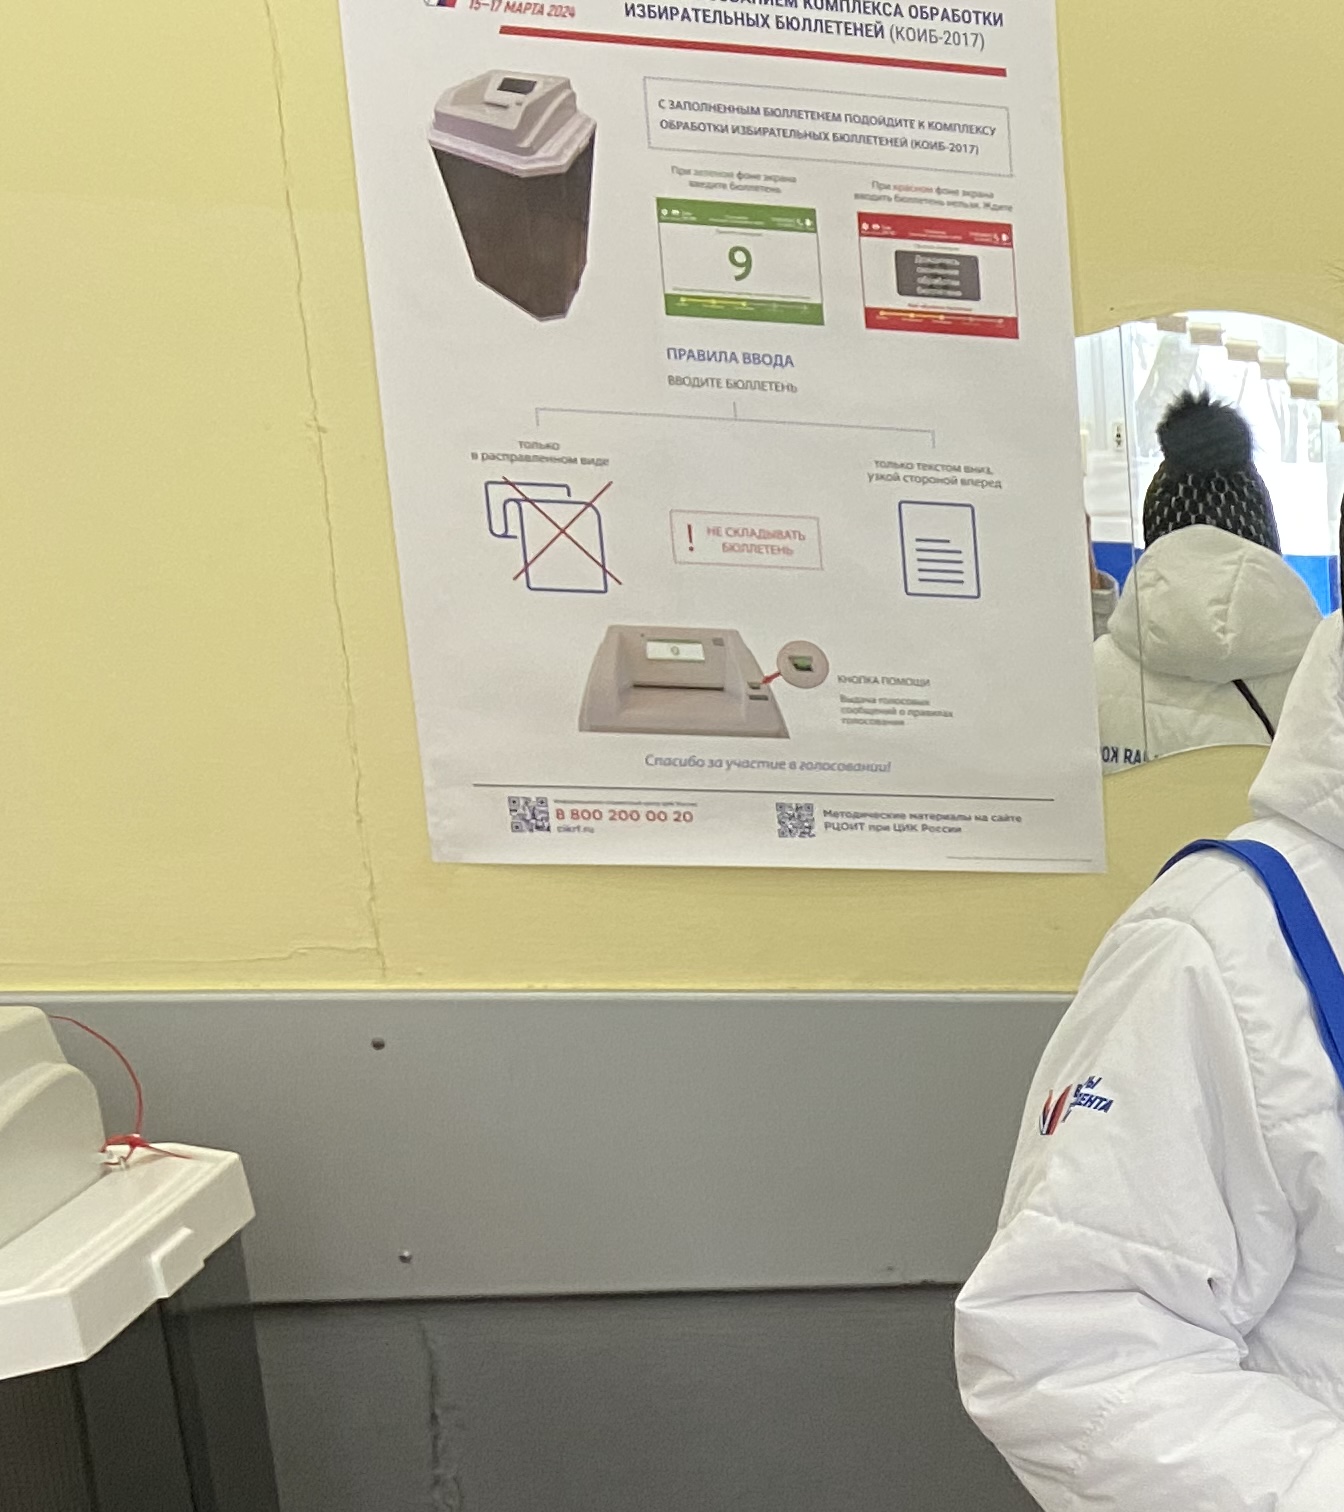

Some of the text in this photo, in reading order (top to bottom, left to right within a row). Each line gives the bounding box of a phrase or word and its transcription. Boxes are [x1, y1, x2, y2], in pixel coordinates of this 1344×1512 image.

[504, 1, 545, 15] МАРТА
[546, 4, 576, 18] 2024
[803, 0, 904, 18] КОМПЛЕКСА
[908, 6, 1004, 27] ОБРАБОТКИ
[624, 2, 985, 52] ИЗБИРАТЕЛЬНЫХ БЮЛЛЕТЕНЕЙ (КОИБ-2017)
[657, 99, 997, 137] С ЗАПОЛНЕННЫМ БЮЛЛЕТЕНЕМ ПОДОЙДИТЕ К КОМПЛЕКСУ
[659, 119, 980, 155] ОБРАБОТКИ ИЗБИРАТЕЛЬНЫХ БЮЛЛЕТЕНЕЙ (КОИБ-2017)
[728, 245, 753, 281] 9
[666, 347, 795, 369] ПРАВИЛА ВВОДА
[667, 374, 798, 393] ВВОДИТЕ БЮЛЛЕТЕНЬ
[518, 440, 560, 451] только
[481, 451, 578, 464] расправленном
[580, 457, 610, 467] виде
[874, 460, 914, 470] только
[916, 462, 962, 472] текстом
[902, 474, 958, 486] стороной
[706, 526, 806, 541] НЕ СКЛАДЫВАТЬ
[721, 542, 794, 556] БЮЛЛЕТЕНЬ
[644, 754, 705, 768] Спасибо
[707, 758, 724, 769] за
[725, 758, 786, 773] участие
[788, 760, 797, 771] в
[555, 808, 694, 823] 8 800 200 00 20
